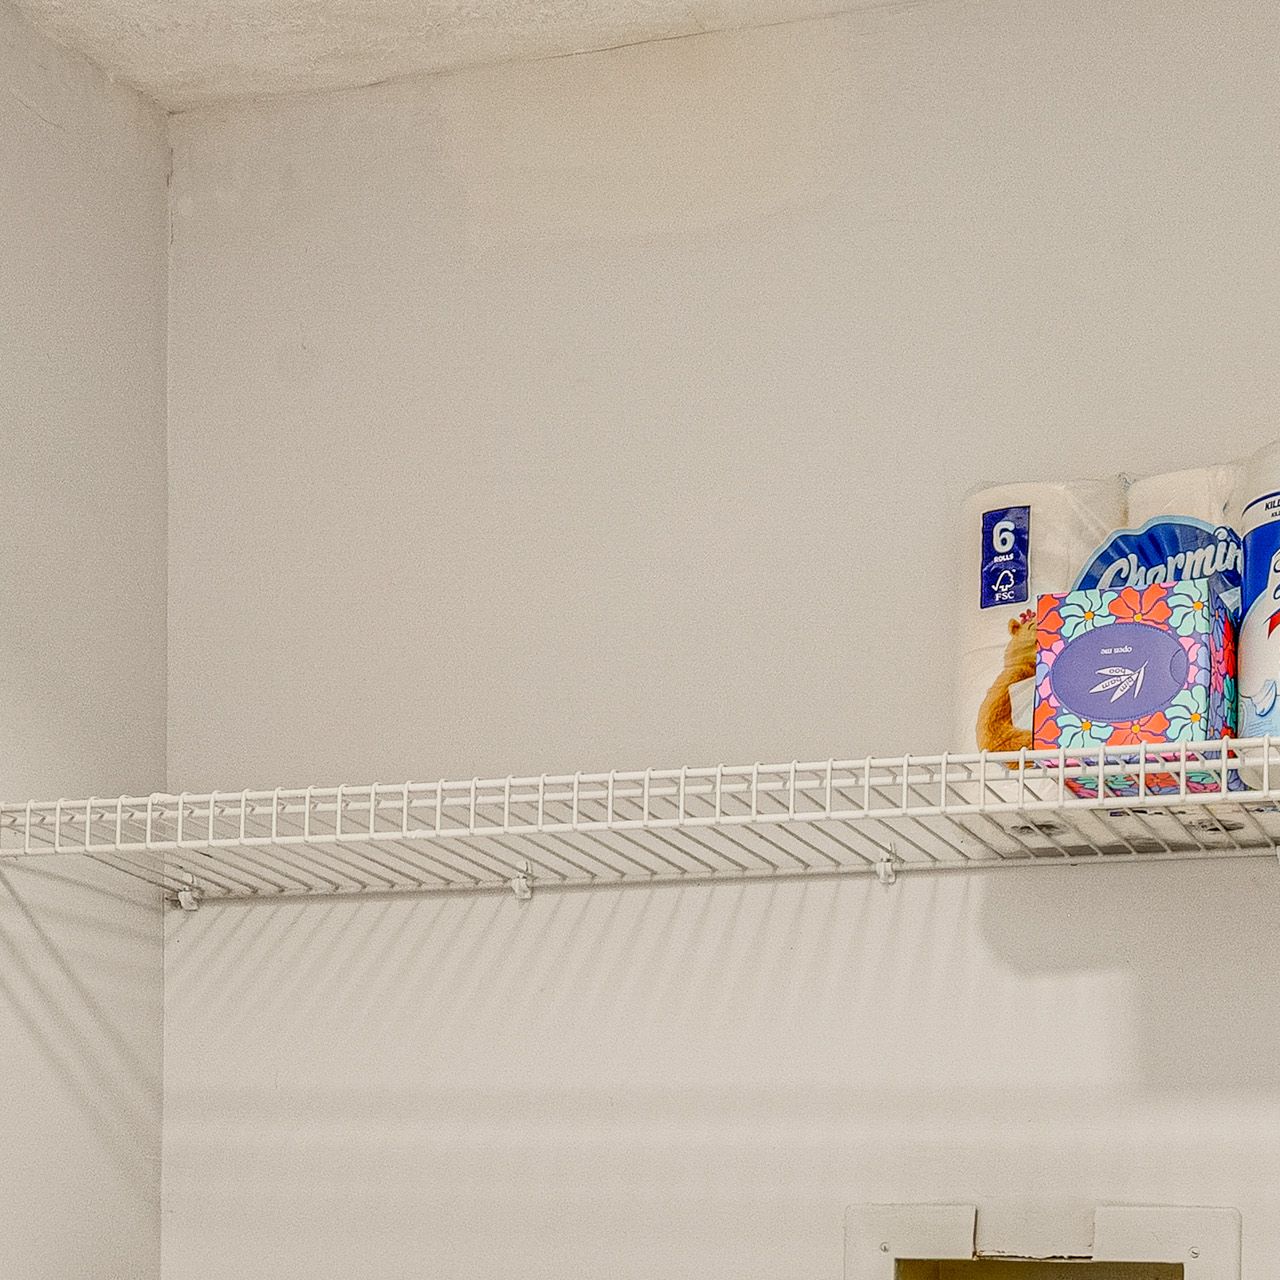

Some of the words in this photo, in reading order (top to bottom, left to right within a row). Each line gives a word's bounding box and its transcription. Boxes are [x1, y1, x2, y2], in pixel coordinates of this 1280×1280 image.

[992, 521, 1015, 553] 6
[994, 553, 1014, 562] ROLLS
[1098, 526, 1241, 590] Charmin
[995, 591, 1014, 601] FSC
[1100, 647, 1112, 655] me
[1114, 645, 1132, 655] open
